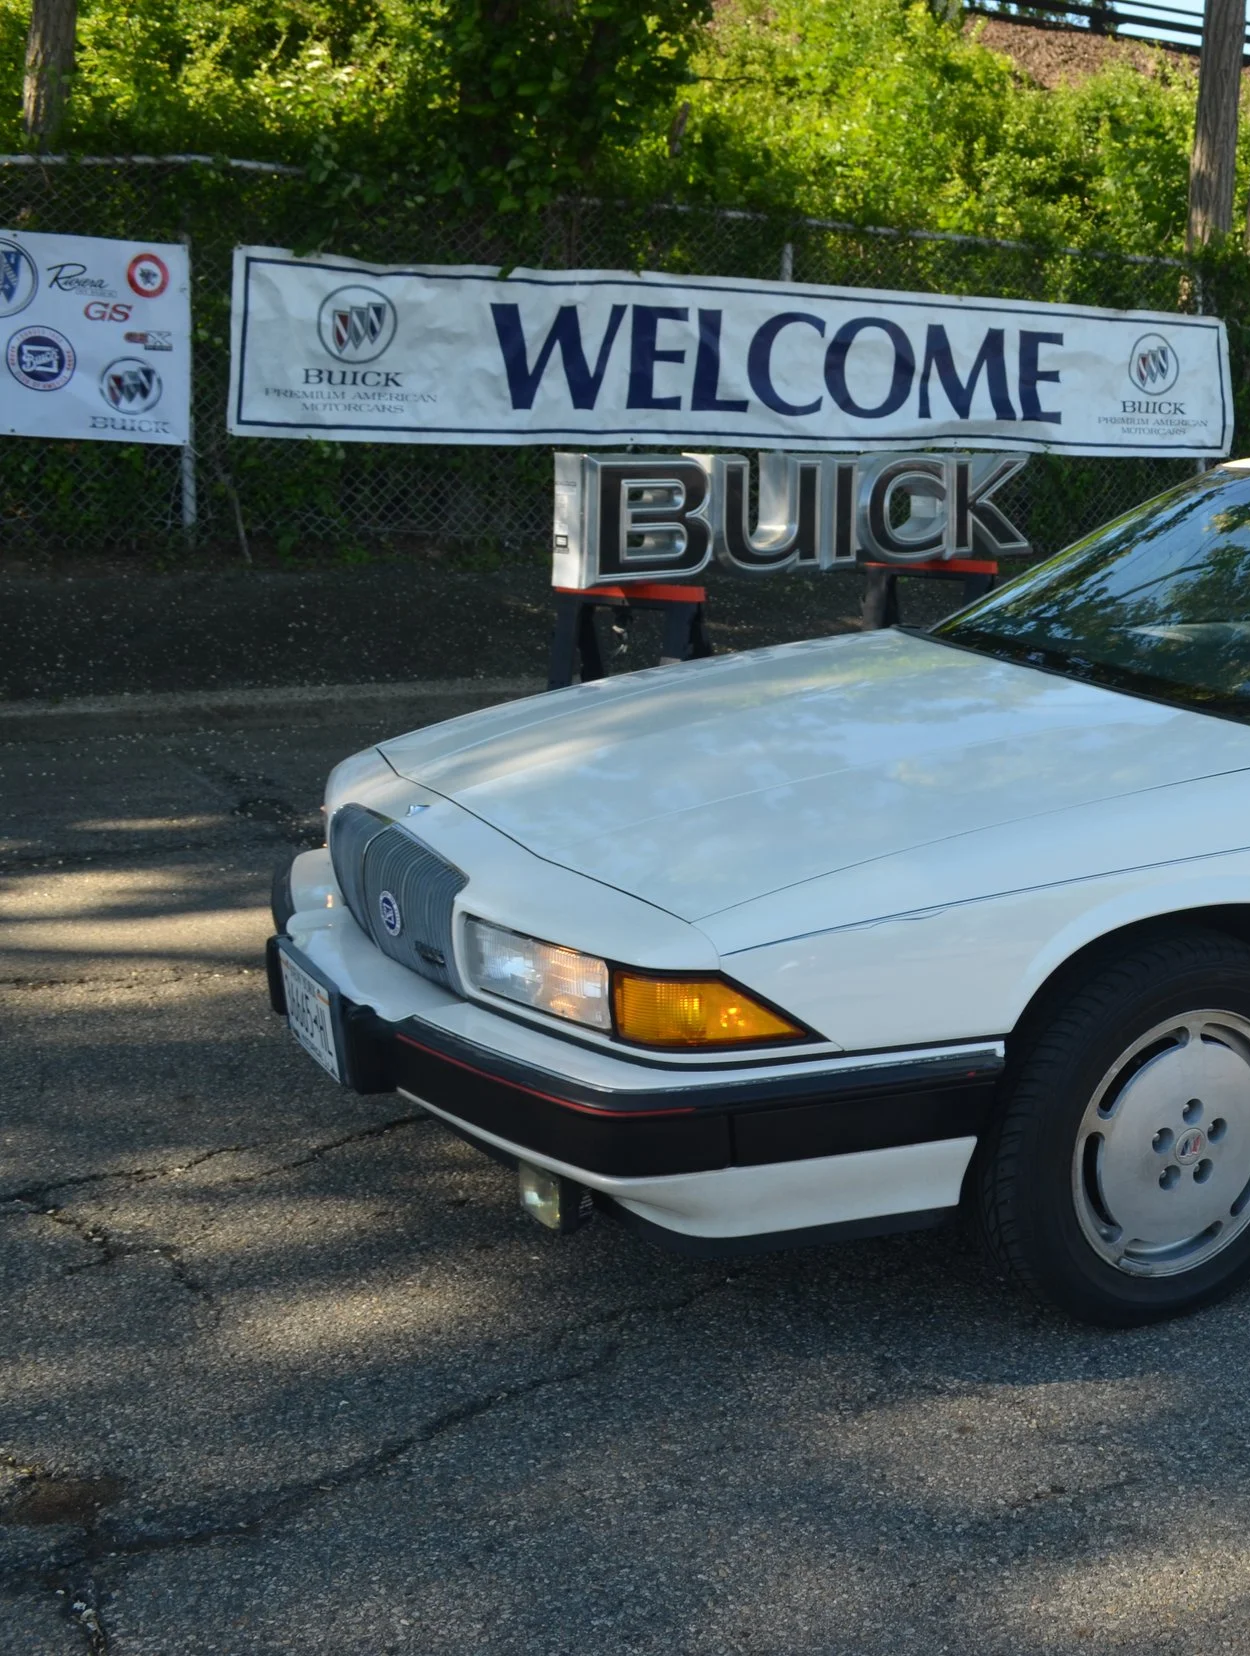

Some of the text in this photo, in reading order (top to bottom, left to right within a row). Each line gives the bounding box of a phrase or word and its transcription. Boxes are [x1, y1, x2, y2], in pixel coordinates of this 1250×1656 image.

[46, 263, 109, 291] Riviera
[83, 301, 133, 323] GS
[490, 302, 1064, 425] WELCOME
[302, 368, 404, 388] BUICK
[264, 387, 438, 403] PREMIUM AMERICAN
[301, 402, 405, 414] MOTORCARS
[1121, 400, 1187, 416] BUICK
[89, 416, 171, 434] BUICK
[580, 453, 1034, 586] BUICK
